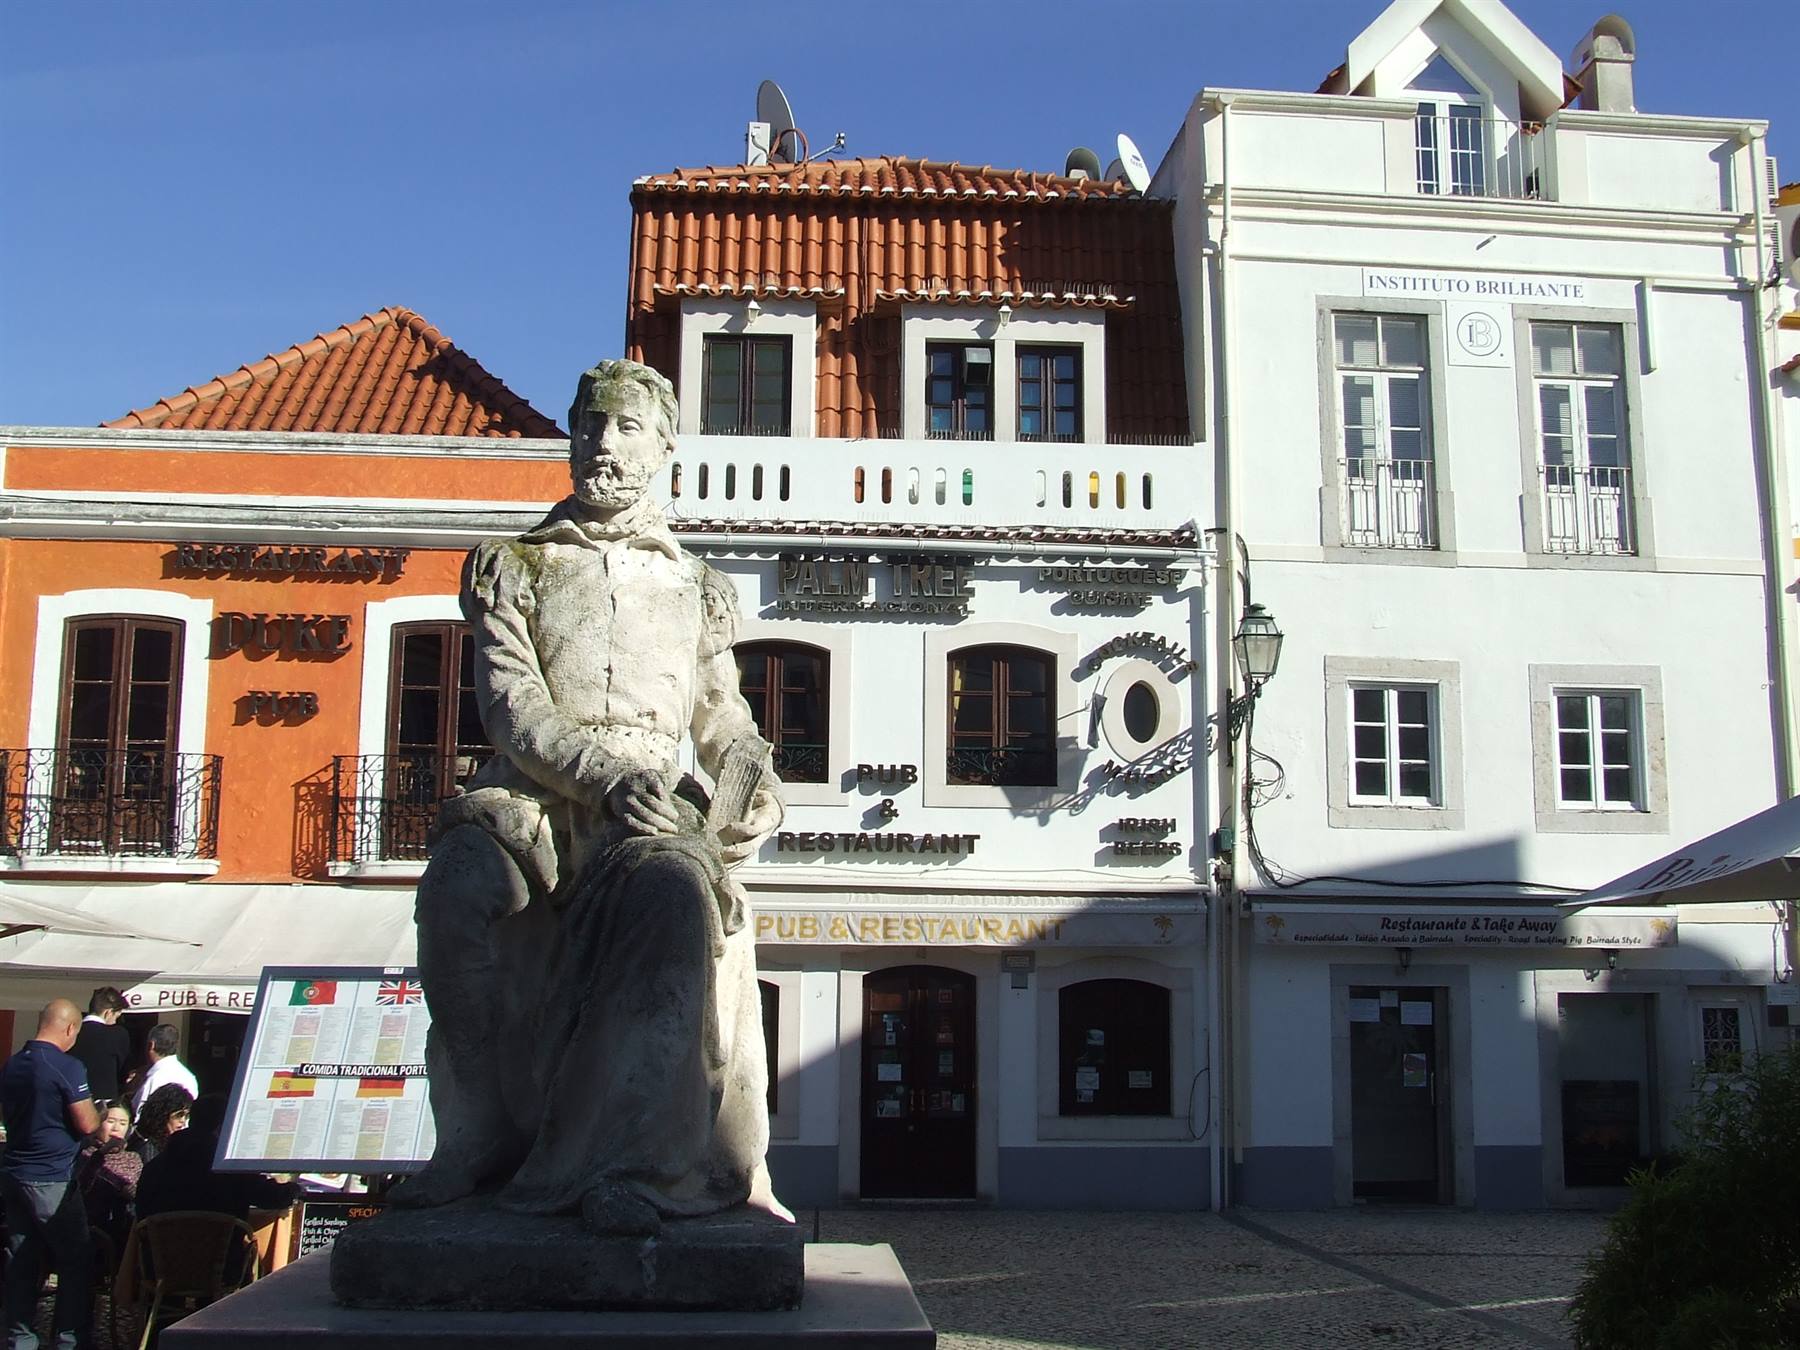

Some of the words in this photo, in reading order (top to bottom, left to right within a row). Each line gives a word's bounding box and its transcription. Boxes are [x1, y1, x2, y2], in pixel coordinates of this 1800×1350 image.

[1369, 275, 1469, 293] INSTITUTO
[1476, 280, 1584, 298] BRILHANTE
[175, 543, 410, 575] RESTAURANT
[777, 552, 869, 596] PALM
[888, 554, 975, 598] TREE
[1038, 567, 1183, 584] PORTUGUESE
[776, 600, 975, 616] INTERNACIONAL
[1070, 590, 1153, 606] CUISINE
[218, 612, 353, 654] DUKE
[1087, 631, 1199, 674] COCKTAILS
[248, 690, 319, 717] PUB
[857, 763, 918, 785] PUB
[879, 798, 899, 818] &
[1118, 818, 1177, 832] IRISH
[777, 831, 980, 854] RESTAURANT
[1113, 842, 1182, 856] BEERS
[754, 916, 818, 939] PUB
[828, 916, 849, 939] &
[859, 917, 1066, 941] RESTAURANT
[1380, 917, 1467, 931] Restaurante
[1471, 917, 1481, 930] &
[1484, 917, 1514, 933] Take
[1517, 918, 1557, 934] Away
[1570, 936, 1582, 945] Pig
[1586, 936, 1620, 944] Bairrada
[1622, 936, 1641, 945] Style
[158, 990, 197, 1006] PUB
[206, 991, 219, 1007] &
[228, 992, 255, 1008] RE
[302, 1064, 338, 1075] COMIDA
[339, 1065, 398, 1076] TRADICIONAL
